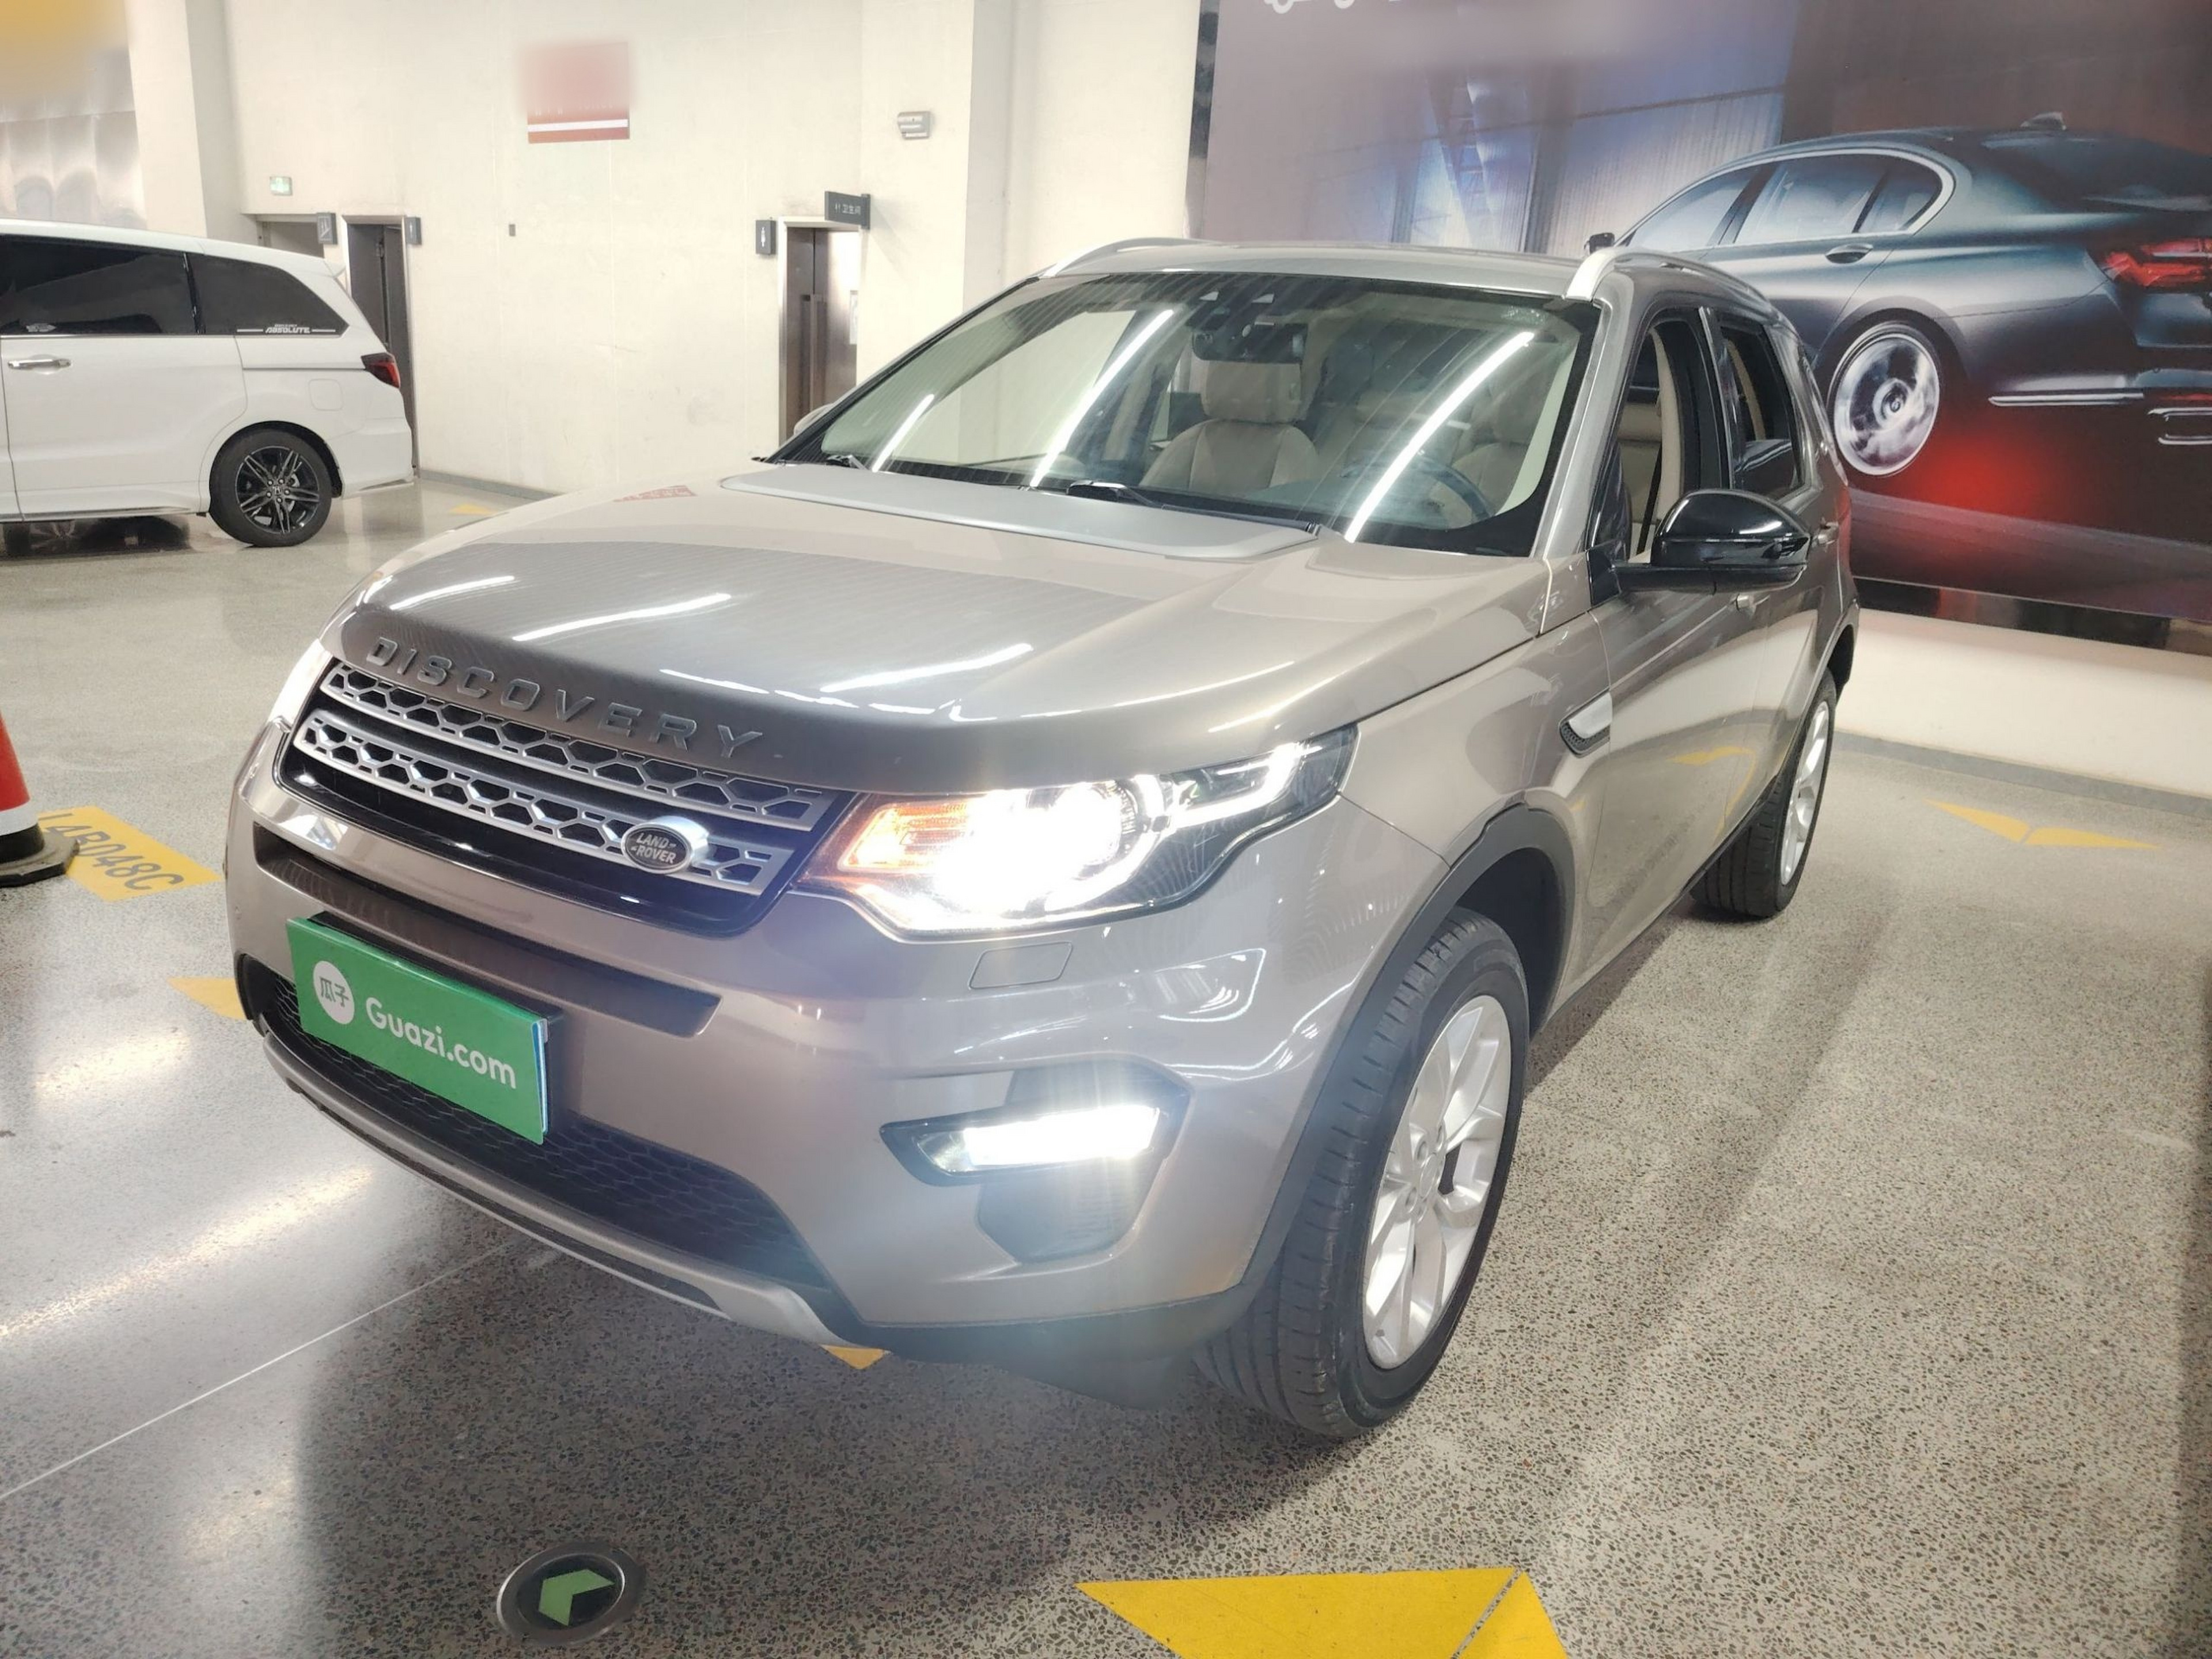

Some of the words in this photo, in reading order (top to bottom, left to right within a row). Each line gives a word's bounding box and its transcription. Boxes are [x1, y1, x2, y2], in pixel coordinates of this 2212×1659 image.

[366, 636, 764, 759] DISCOVERY
[635, 832, 669, 849] LAND
[636, 844, 677, 864] ROVER
[320, 977, 350, 1007] 瓜子
[365, 997, 517, 1089] Guazi.com
